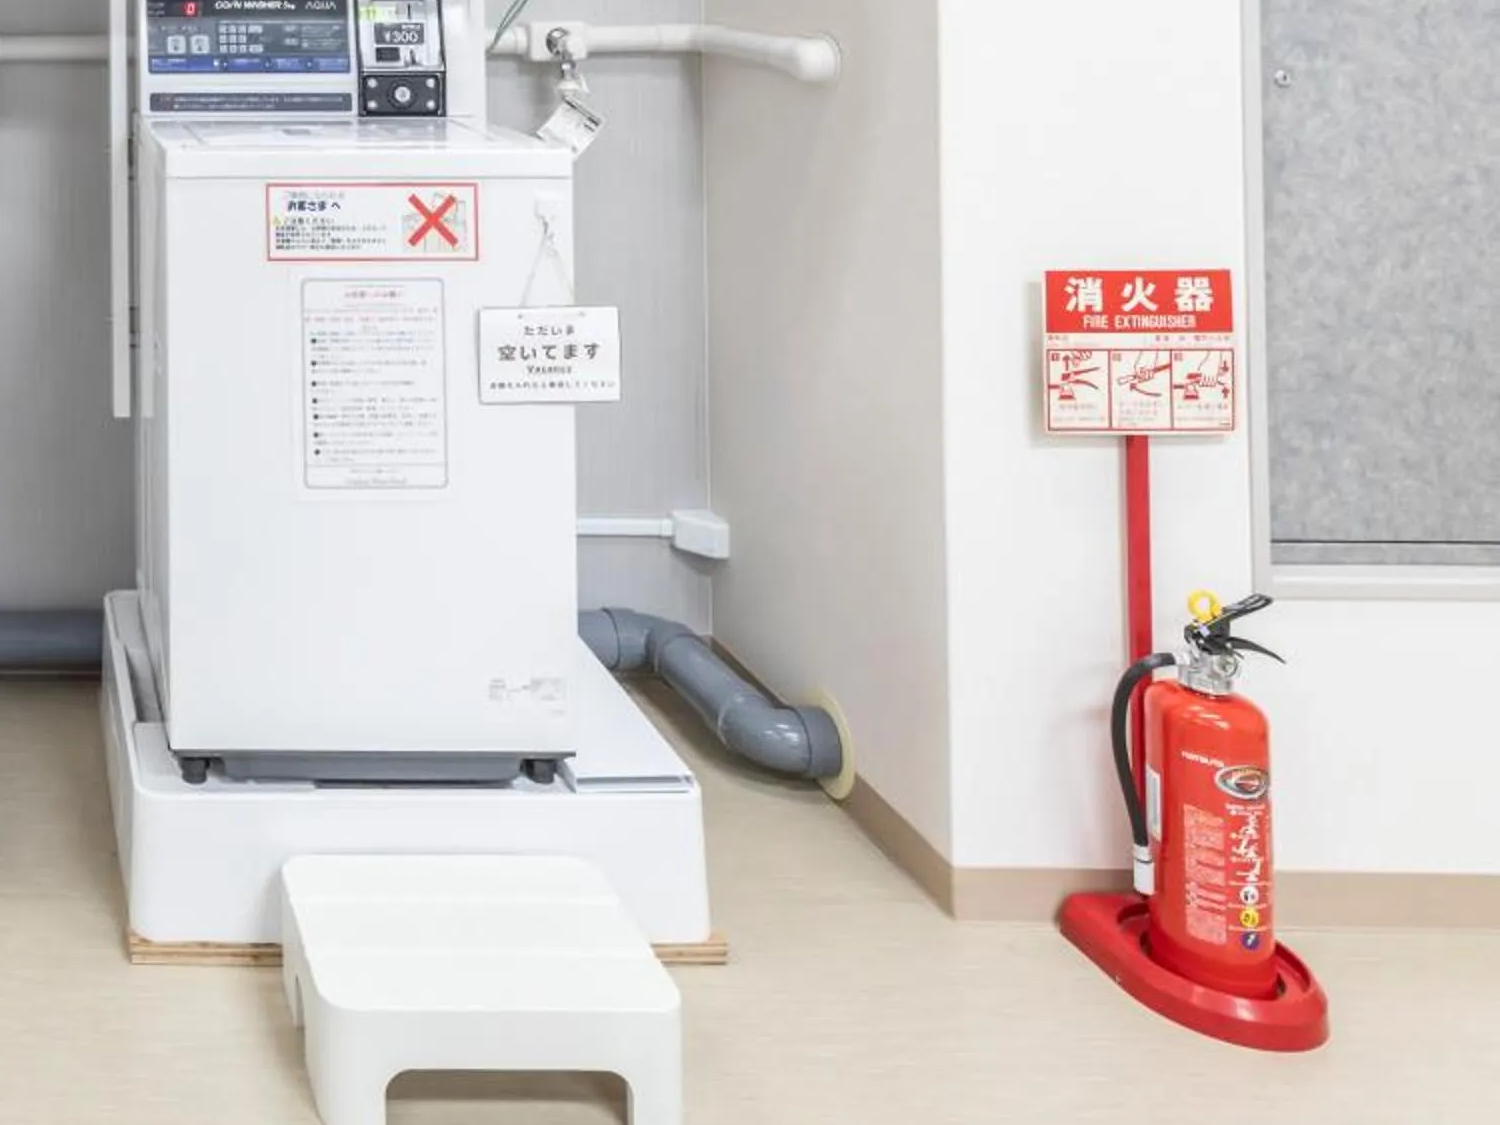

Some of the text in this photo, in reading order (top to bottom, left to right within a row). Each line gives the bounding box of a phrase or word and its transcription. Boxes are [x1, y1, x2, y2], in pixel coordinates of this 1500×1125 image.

[304, 0, 337, 10] AQUA
[1064, 276, 1214, 313] 消火器
[1082, 314, 1197, 329] FIRE EXTINGUISHER
[523, 324, 576, 336] ただいま
[497, 342, 601, 362] 空いてます
